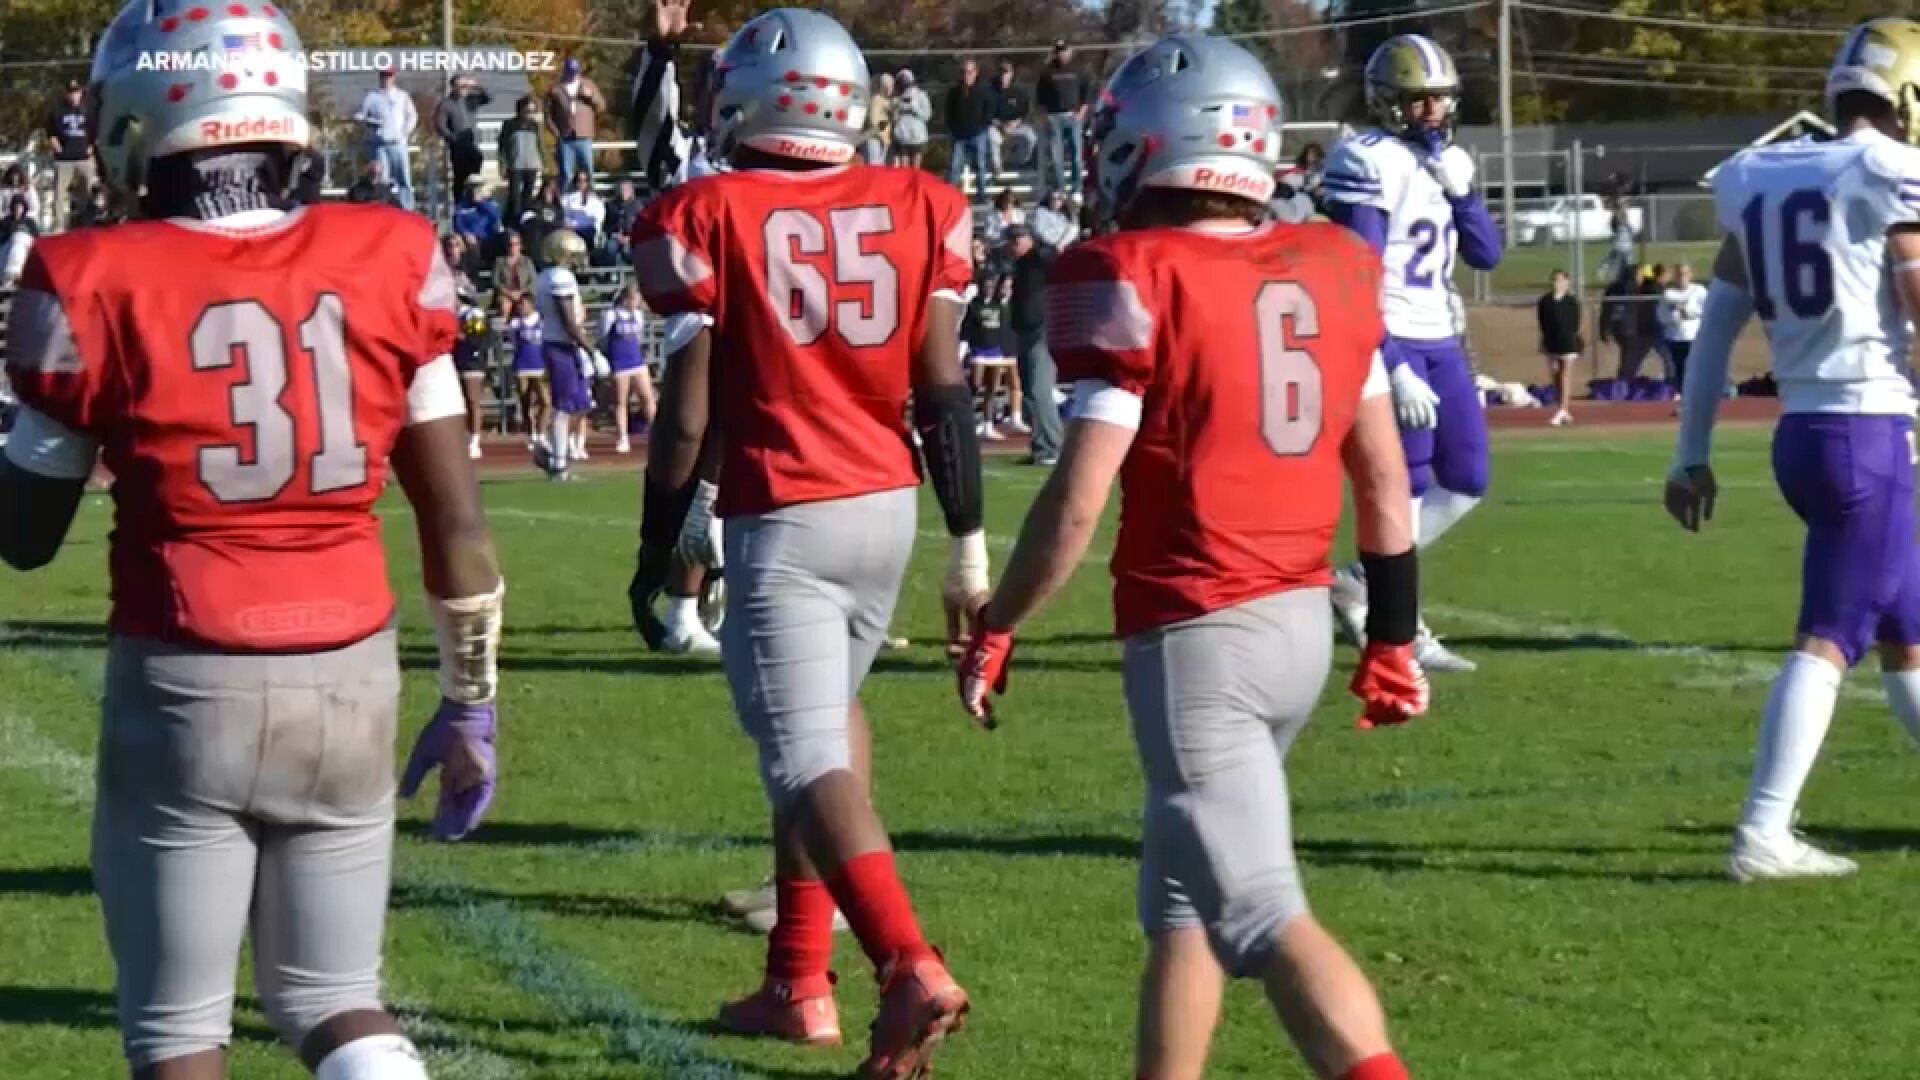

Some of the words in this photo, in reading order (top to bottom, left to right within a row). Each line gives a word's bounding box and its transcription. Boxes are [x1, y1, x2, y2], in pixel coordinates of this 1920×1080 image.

[201, 117, 295, 139] Riddell
[761, 204, 898, 347] 65
[1742, 188, 1835, 320] 16
[188, 291, 369, 504] 31
[1254, 279, 1323, 457] 6
